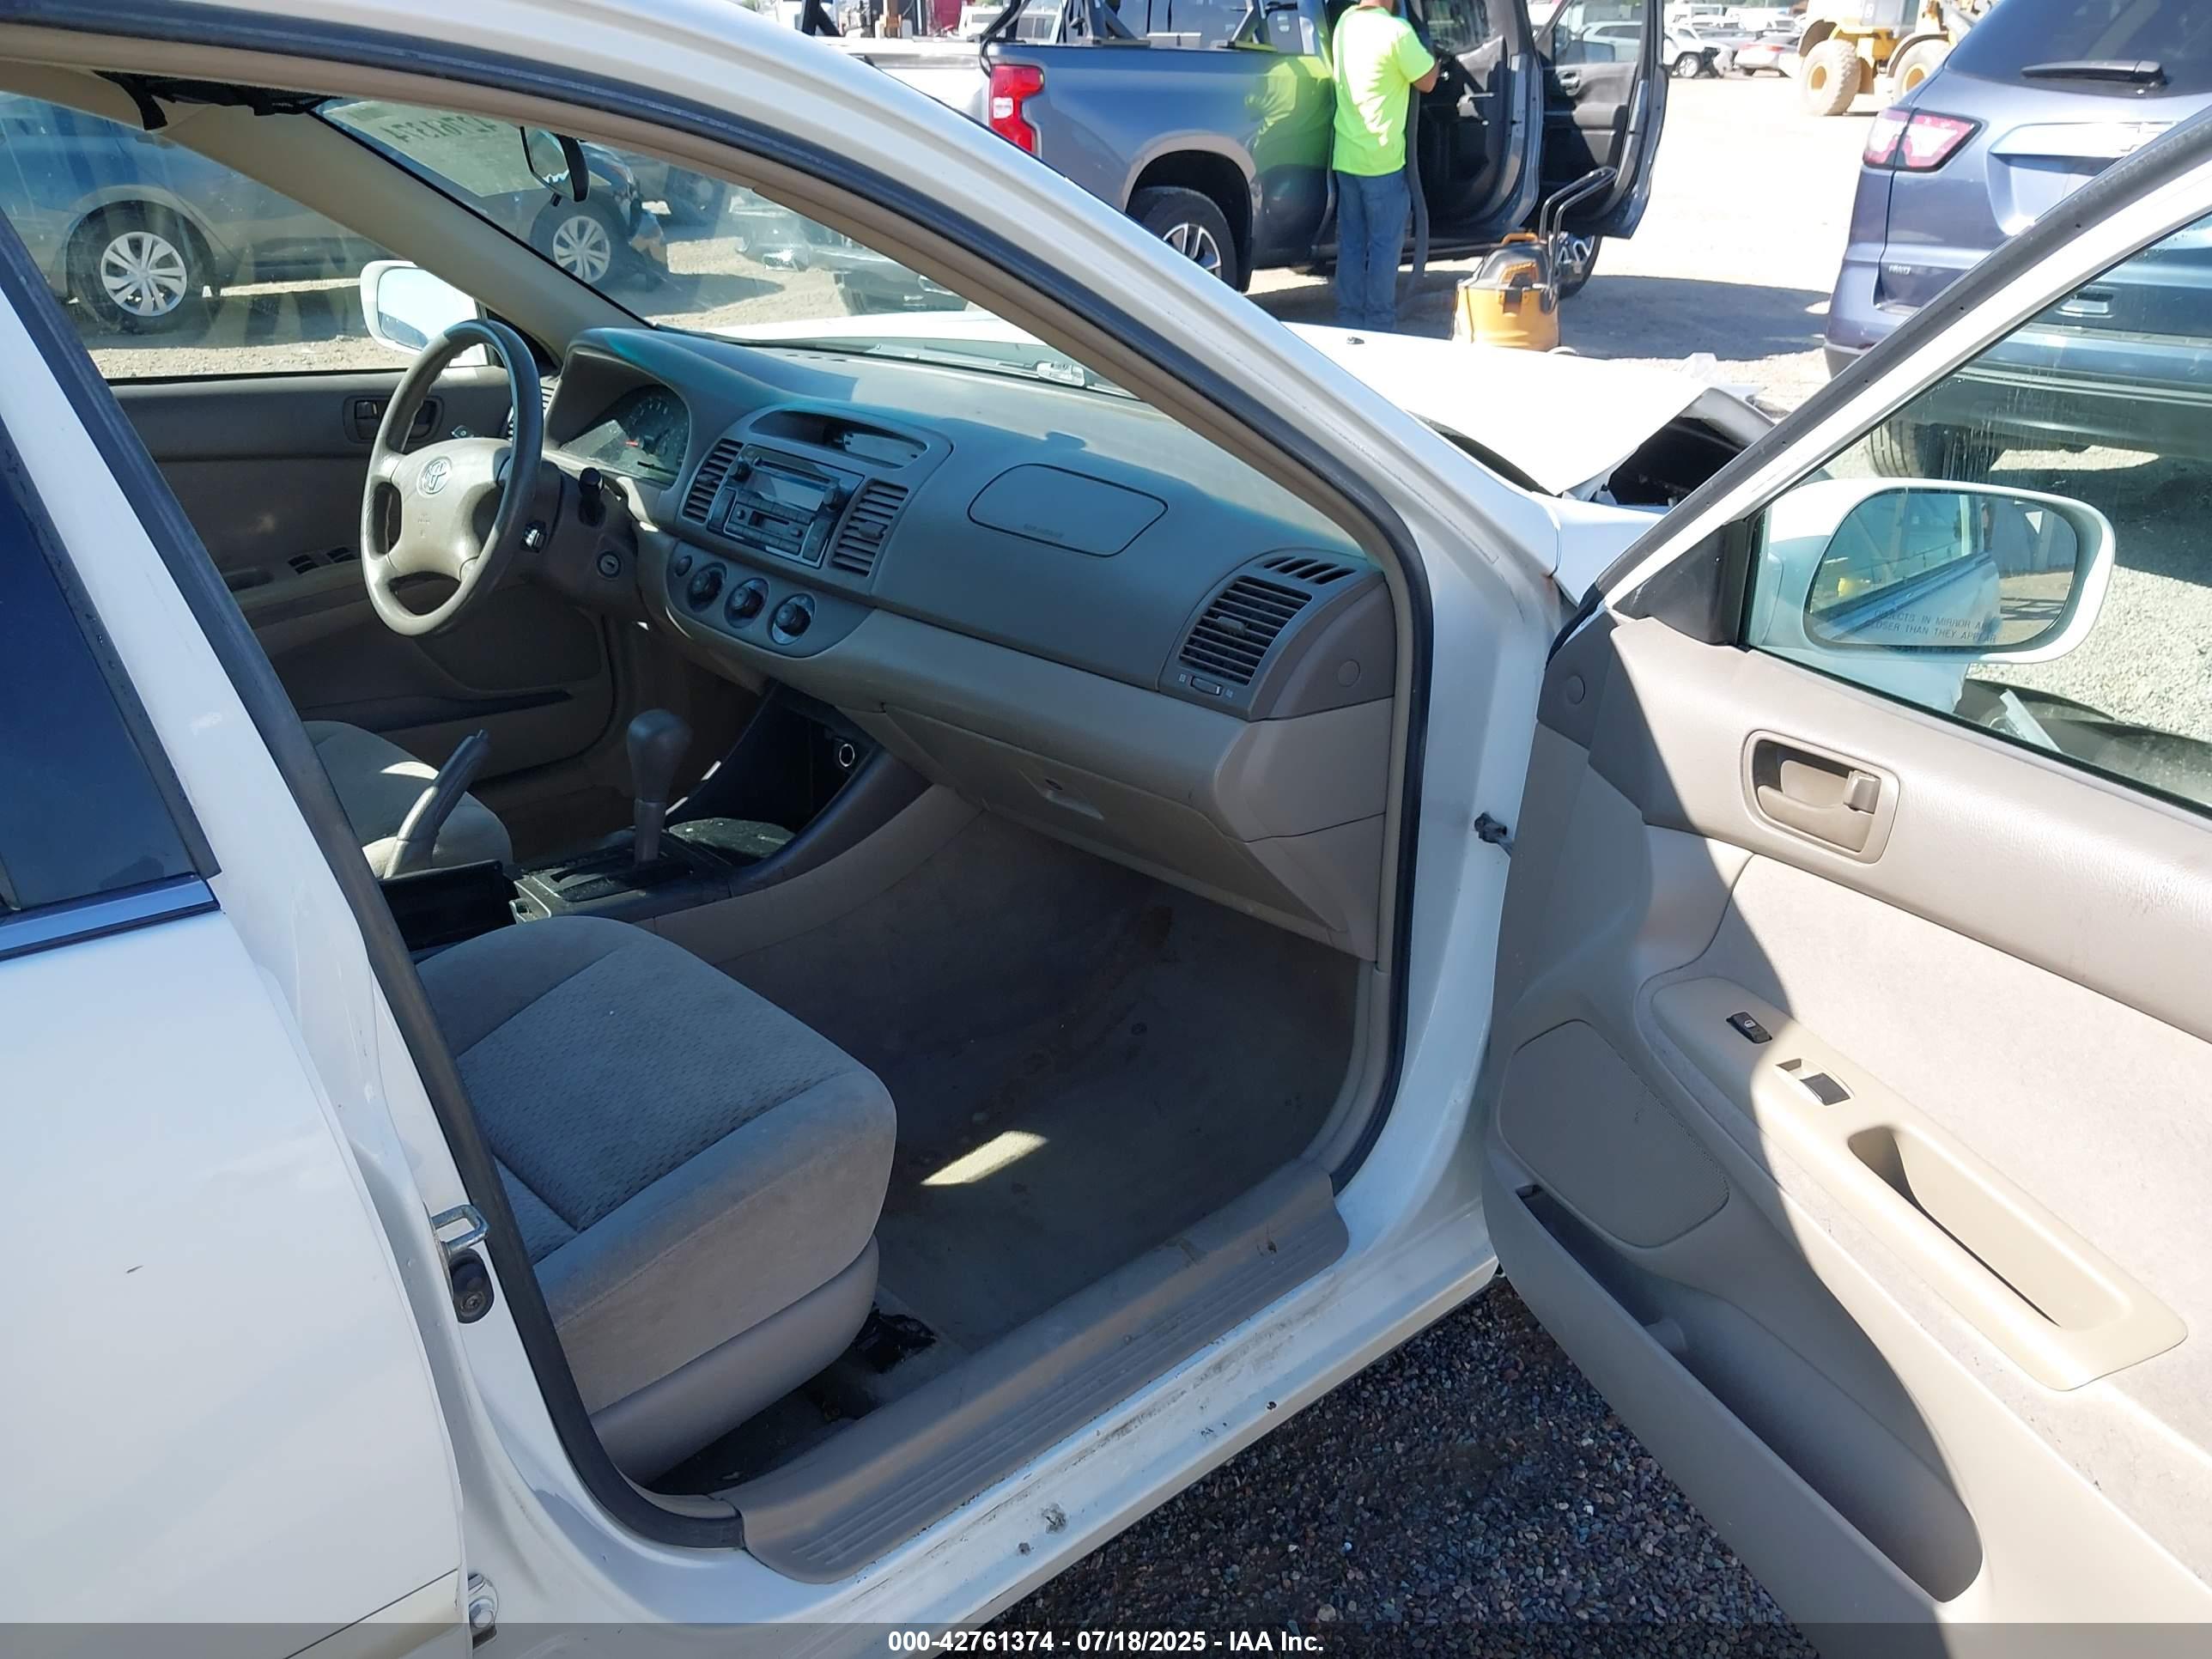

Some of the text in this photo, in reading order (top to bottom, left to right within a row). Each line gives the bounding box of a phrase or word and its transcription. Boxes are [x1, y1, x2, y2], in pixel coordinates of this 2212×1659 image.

[1921, 614, 1931, 624] IN
[1936, 617, 1971, 629] MIRROR
[1905, 624, 1929, 635] THAN
[1935, 628, 1957, 639] THEY
